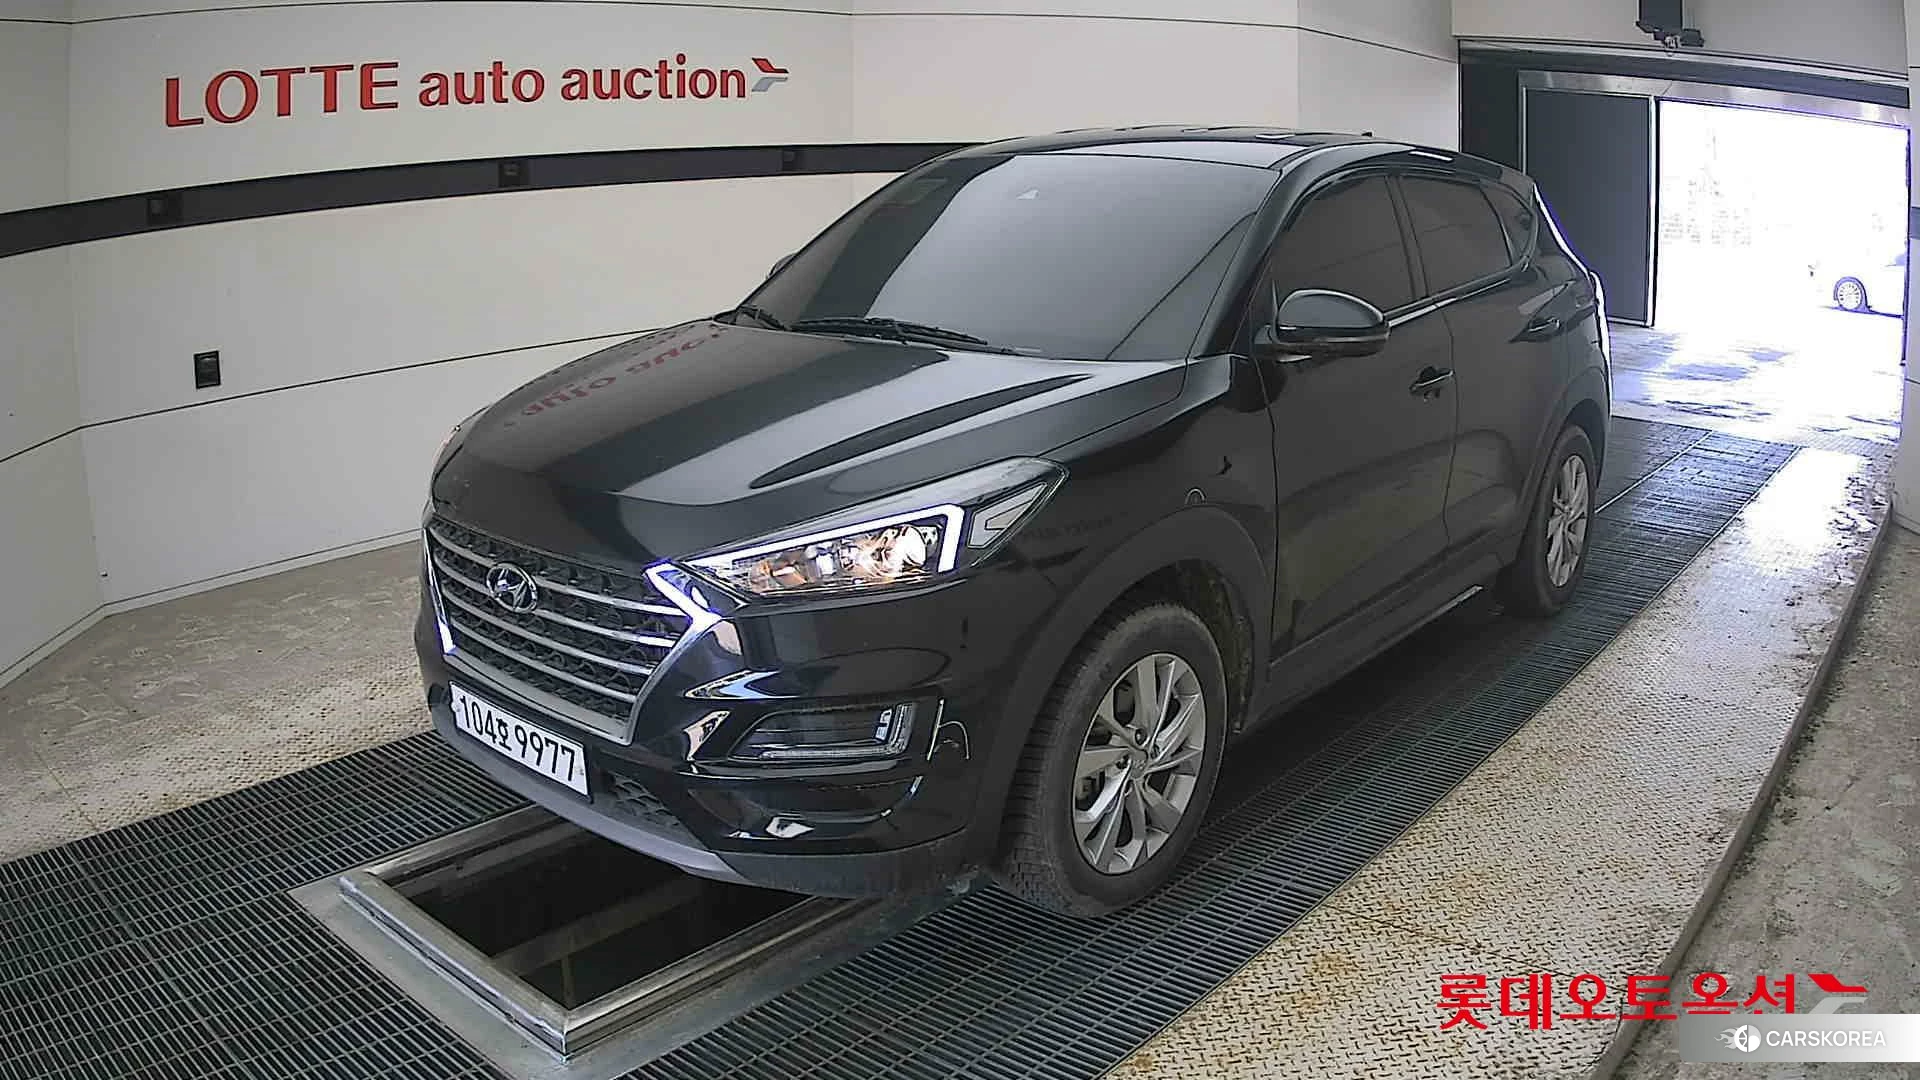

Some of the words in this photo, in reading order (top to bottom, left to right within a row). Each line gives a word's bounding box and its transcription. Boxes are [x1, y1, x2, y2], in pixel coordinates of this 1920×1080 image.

[165, 60, 399, 128] LOTTE
[418, 60, 546, 107] auto
[560, 53, 746, 101] auction
[514, 725, 576, 782] 9977
